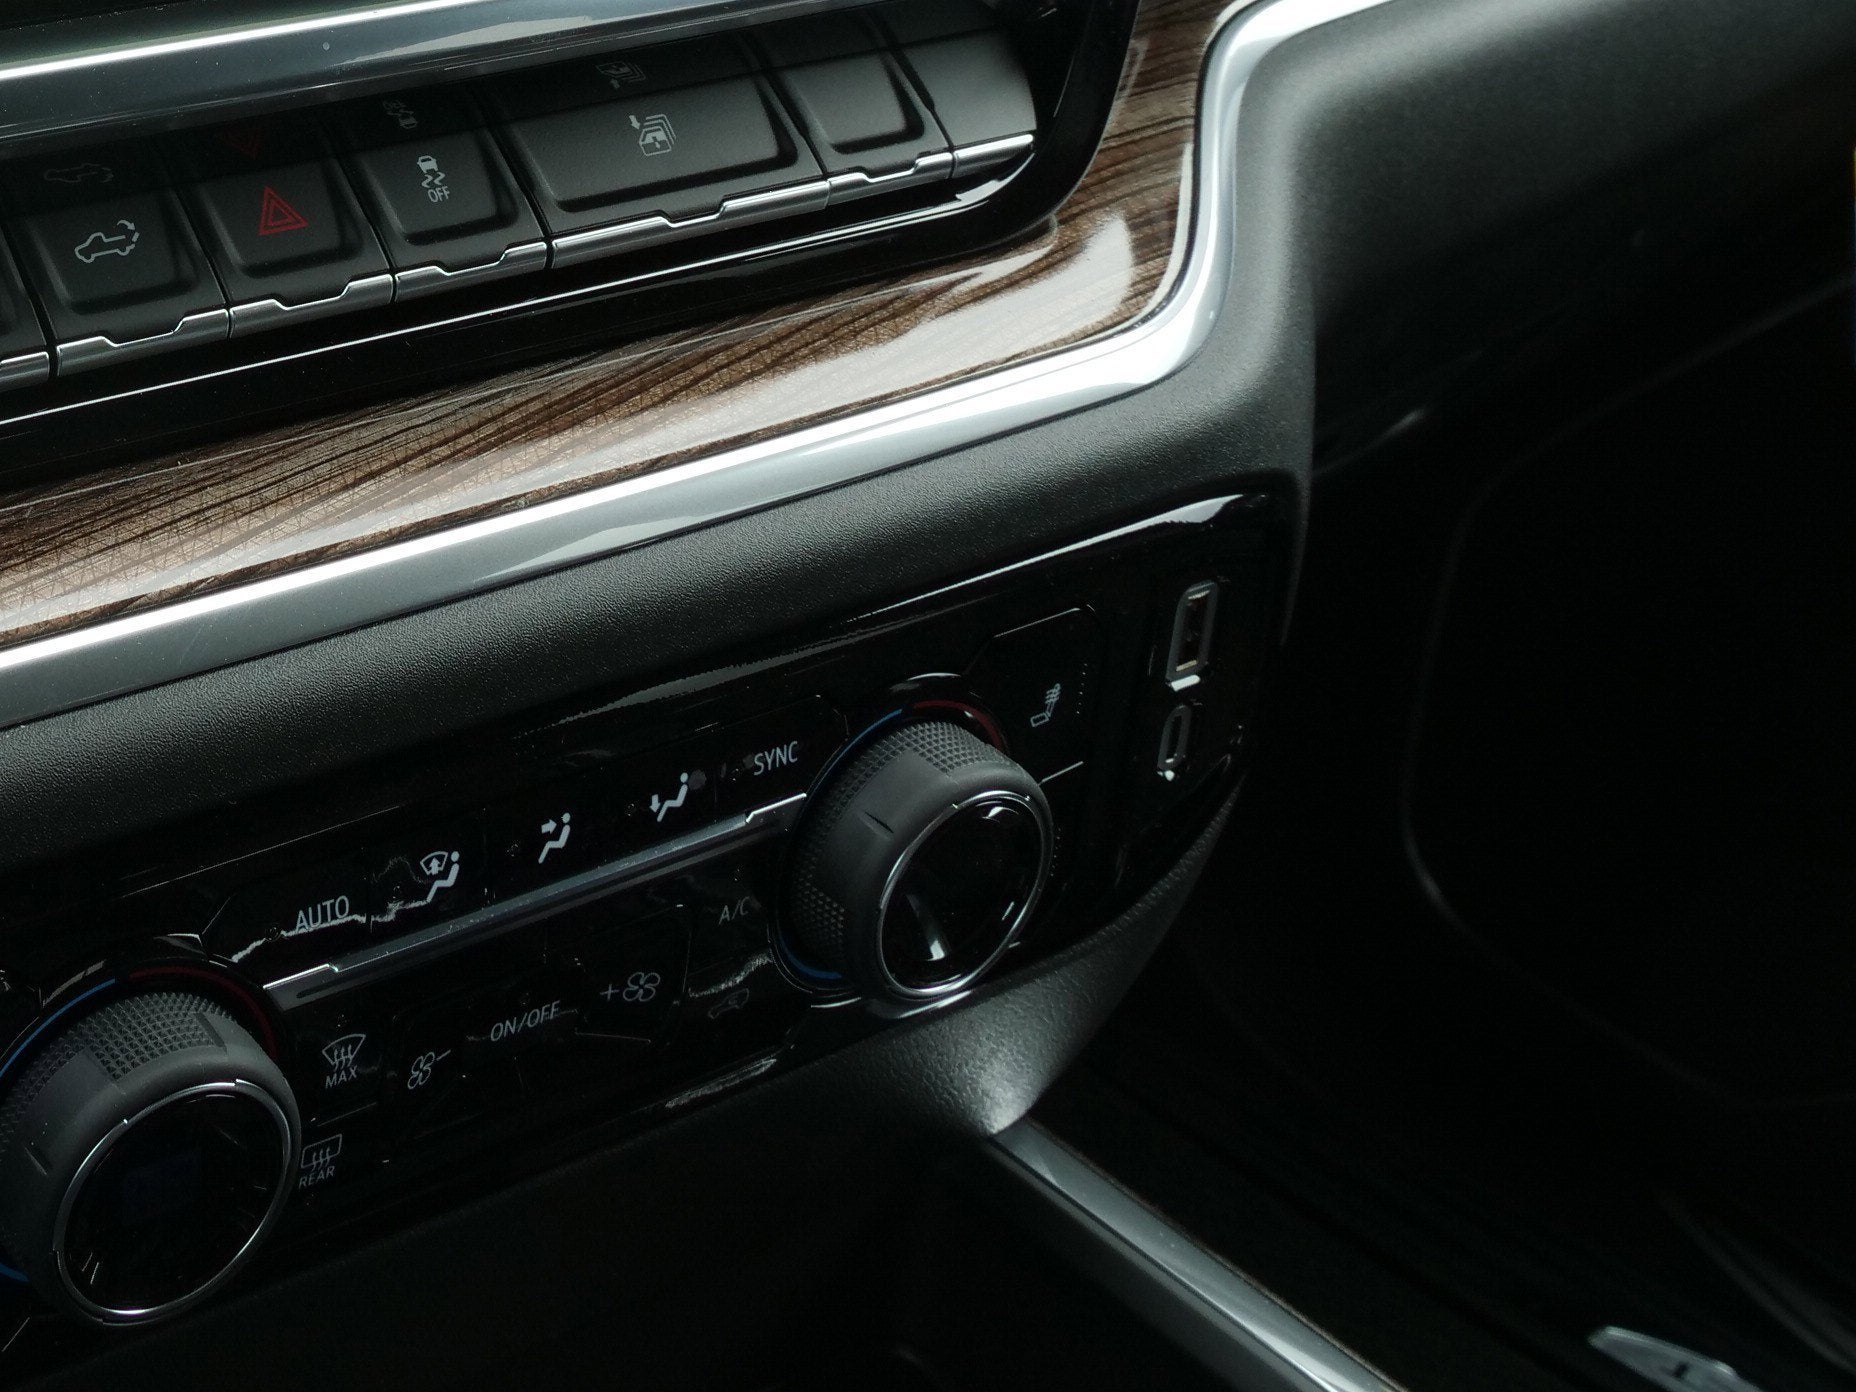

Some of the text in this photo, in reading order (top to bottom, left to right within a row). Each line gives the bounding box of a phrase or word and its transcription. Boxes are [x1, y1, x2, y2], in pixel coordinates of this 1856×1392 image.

[427, 186, 451, 205] OFF
[753, 740, 799, 776] SYNC
[294, 895, 350, 933] AUTO
[718, 896, 751, 926] A/C
[490, 1000, 561, 1042] ON/OFF
[324, 1065, 358, 1090] MAX
[298, 1165, 336, 1188] REAR
